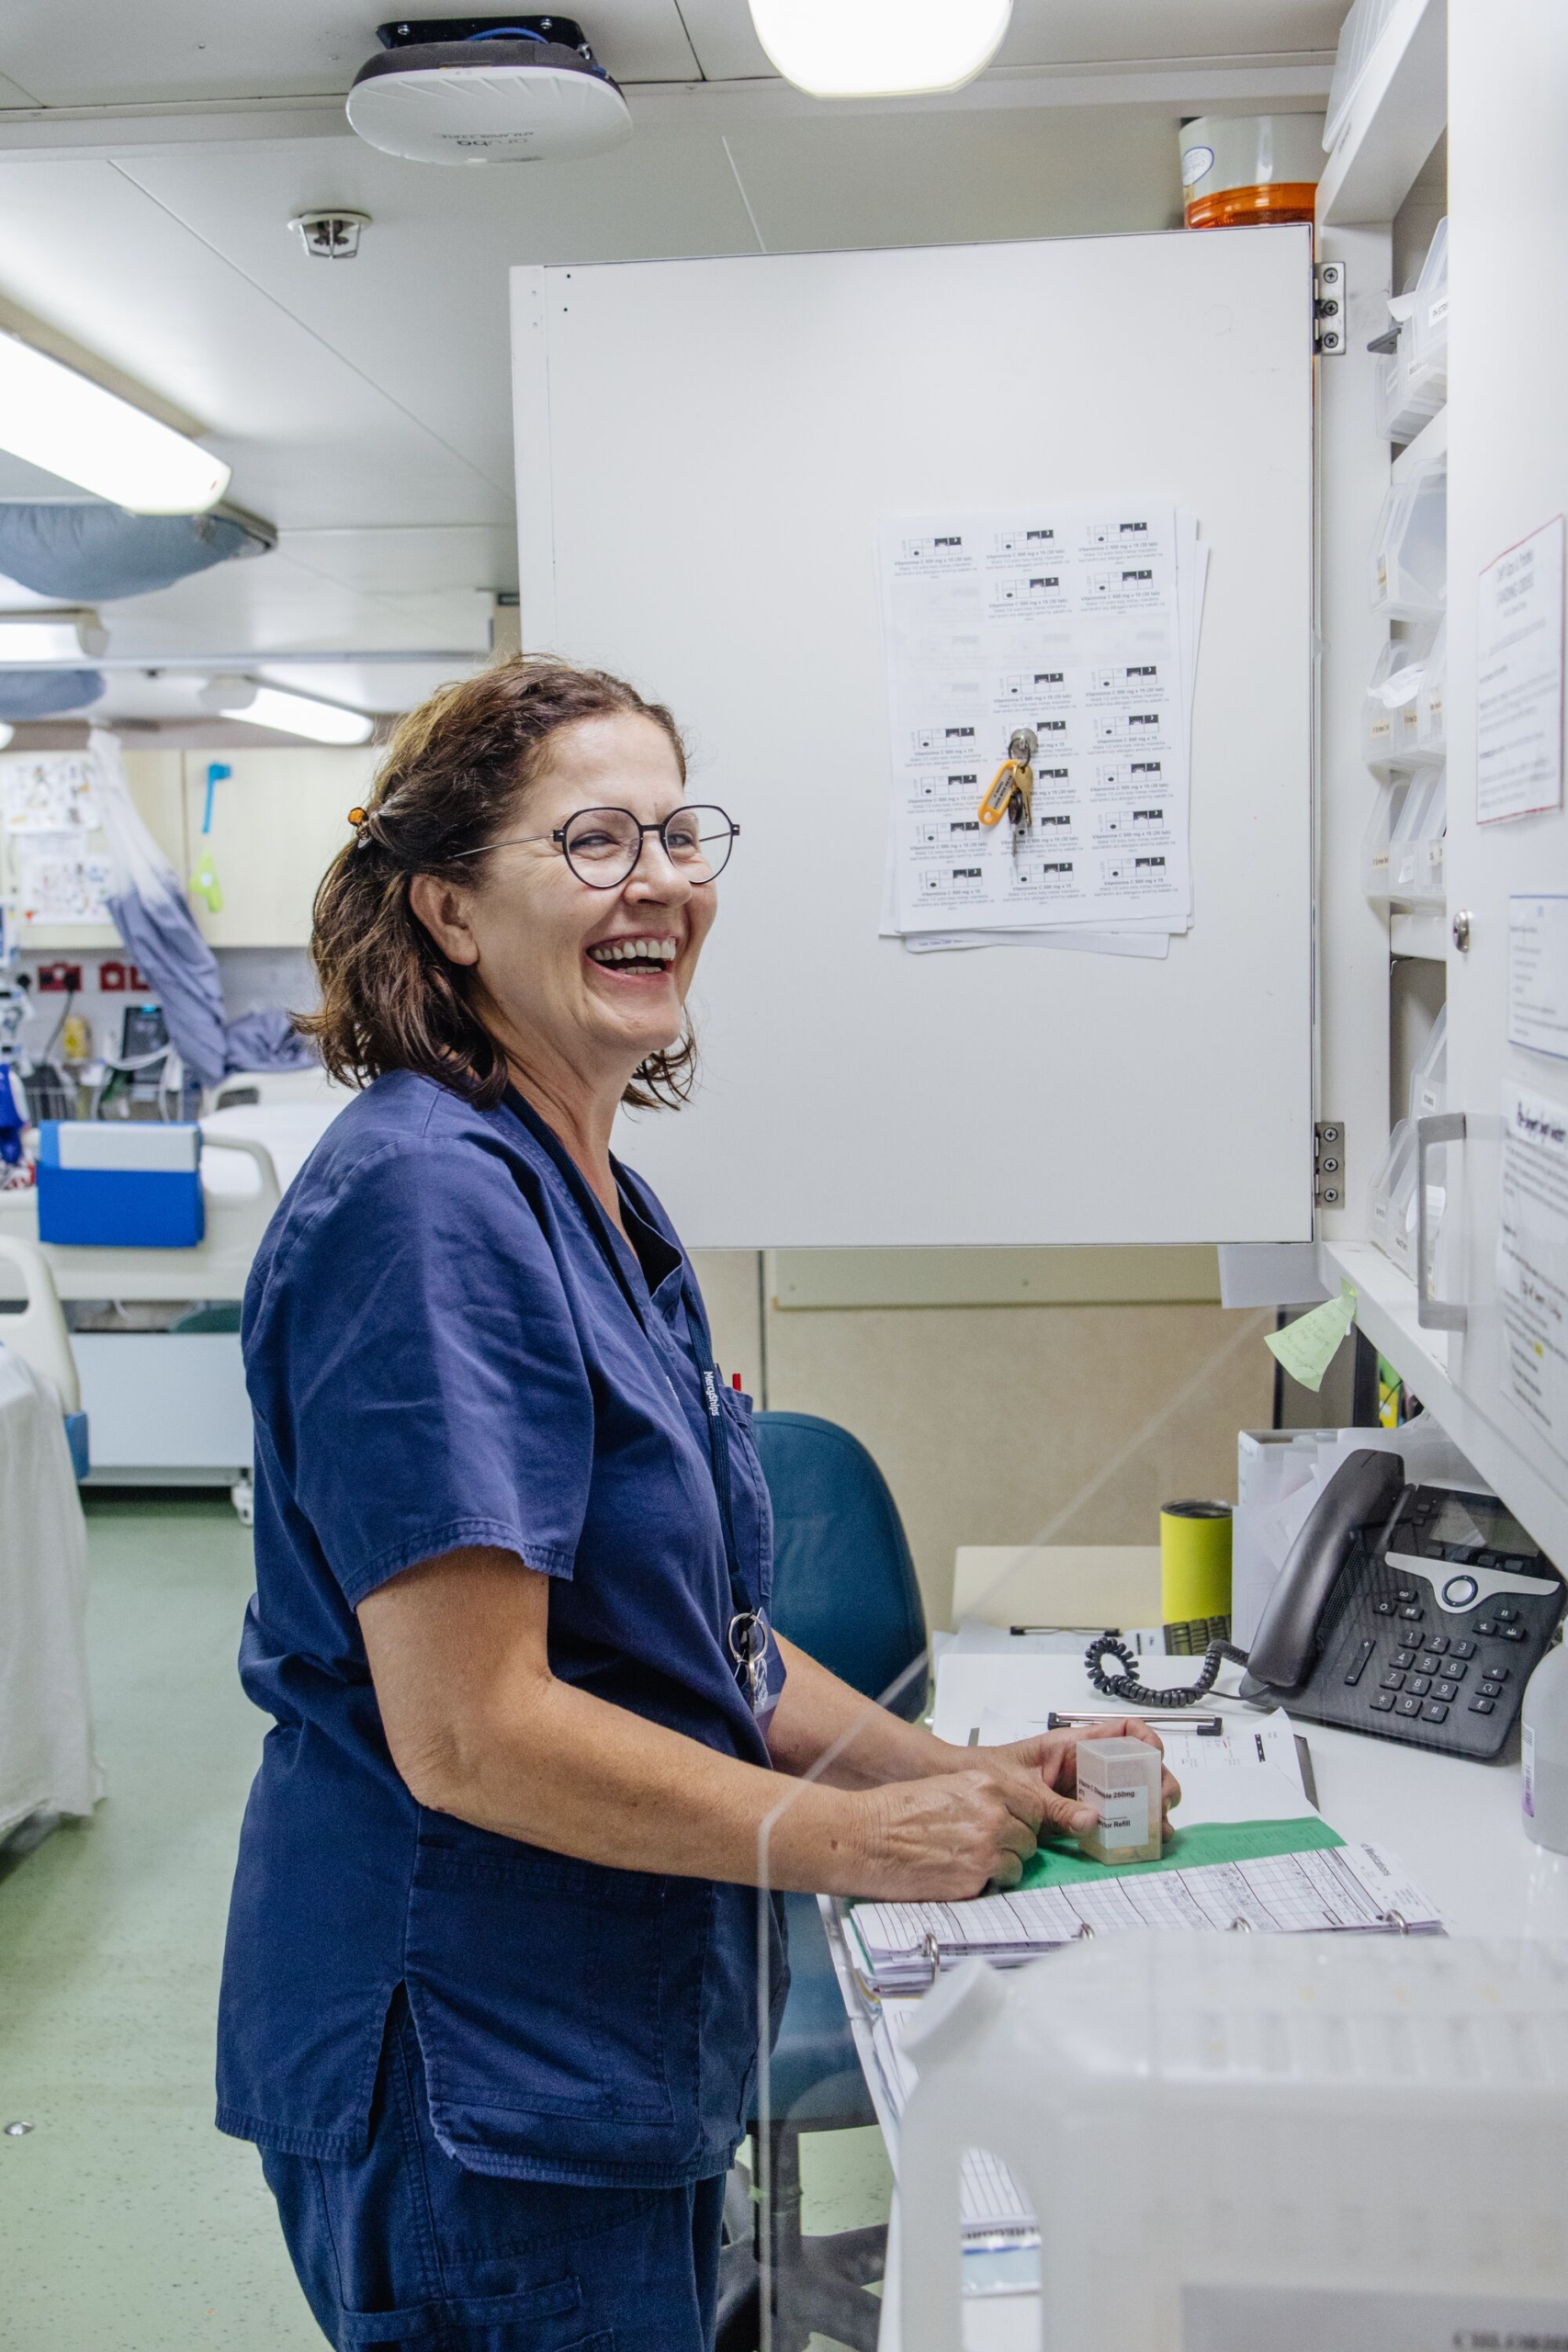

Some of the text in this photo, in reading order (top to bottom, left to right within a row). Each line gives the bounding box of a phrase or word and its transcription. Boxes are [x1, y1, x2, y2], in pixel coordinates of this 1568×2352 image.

[457, 139, 528, 147] aruba
[704, 1371, 719, 1417] MercyShips
[1441, 1685, 1448, 1693] 9
